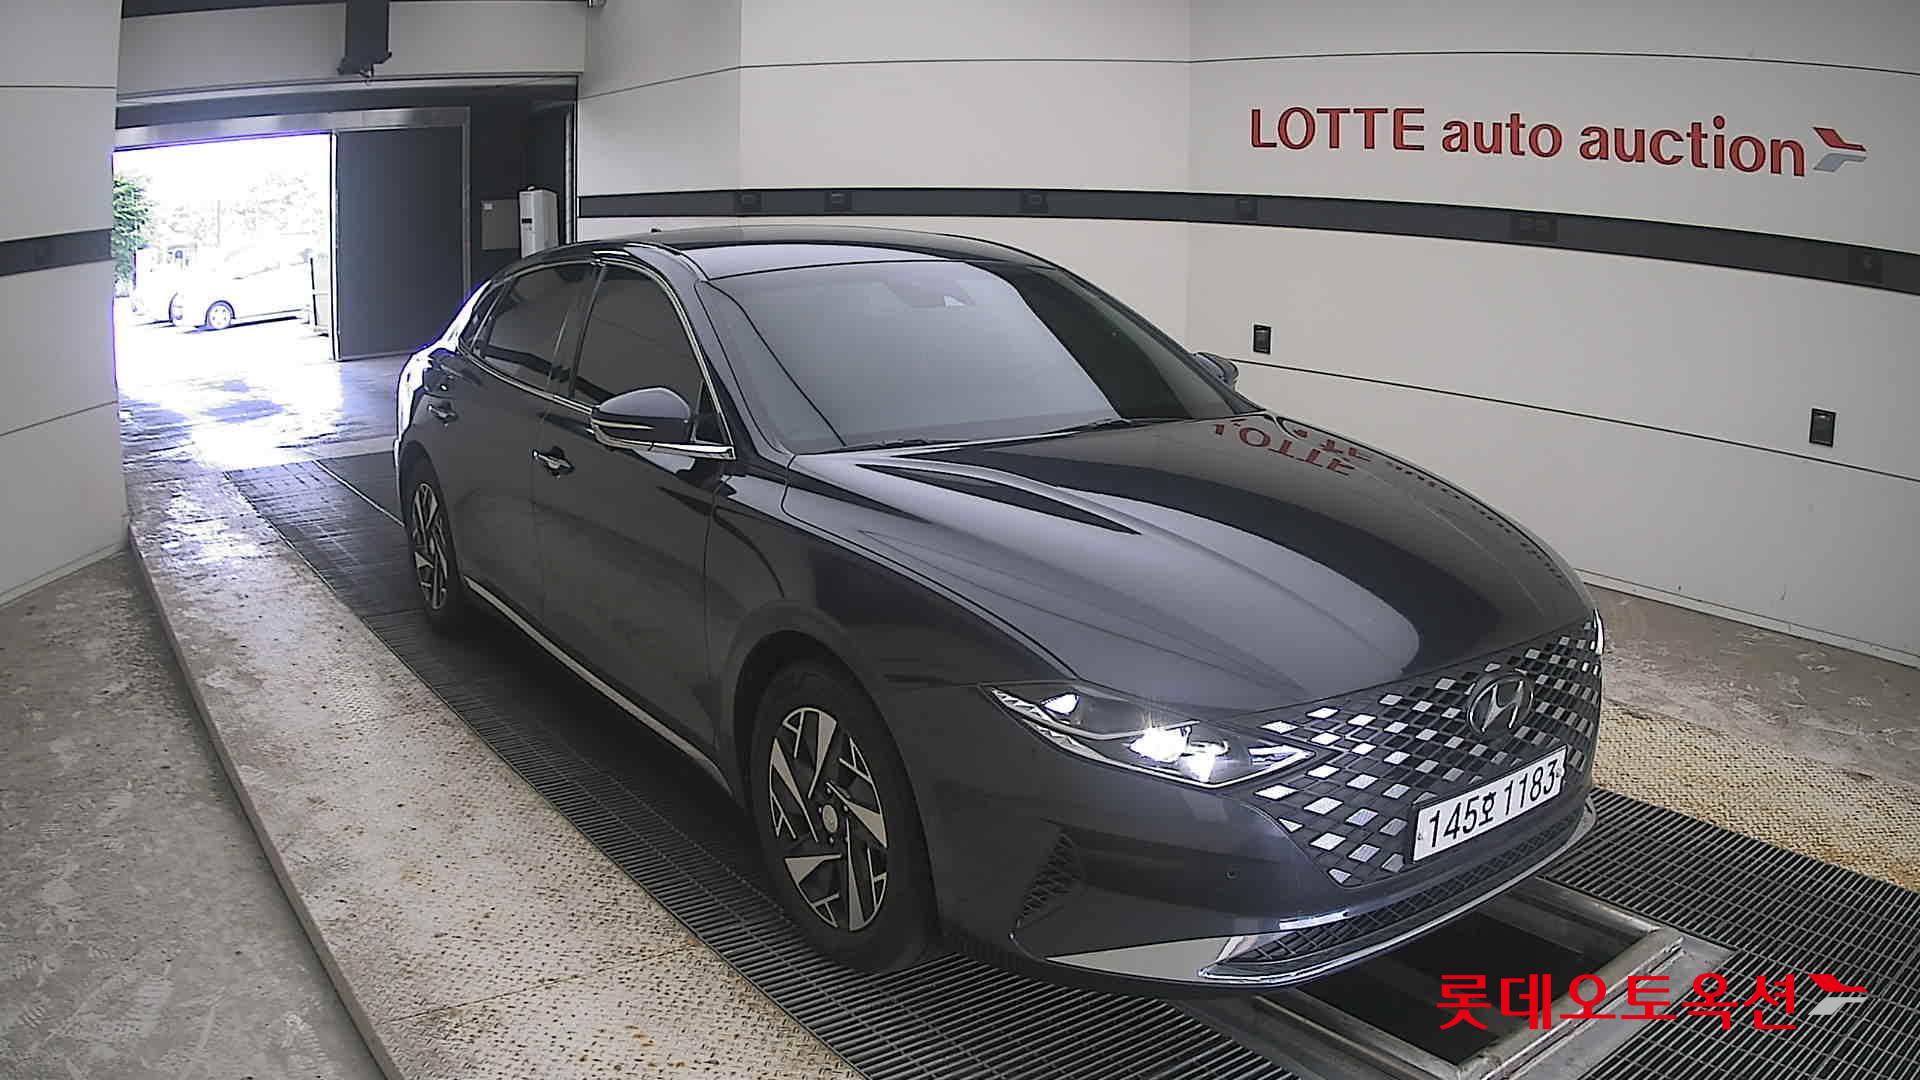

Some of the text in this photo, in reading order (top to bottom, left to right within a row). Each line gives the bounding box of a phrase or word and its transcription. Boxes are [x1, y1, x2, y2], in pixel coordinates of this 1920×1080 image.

[1250, 107, 1806, 177] LOTTE auto auction
[1429, 759, 1557, 848] 145호 1183
